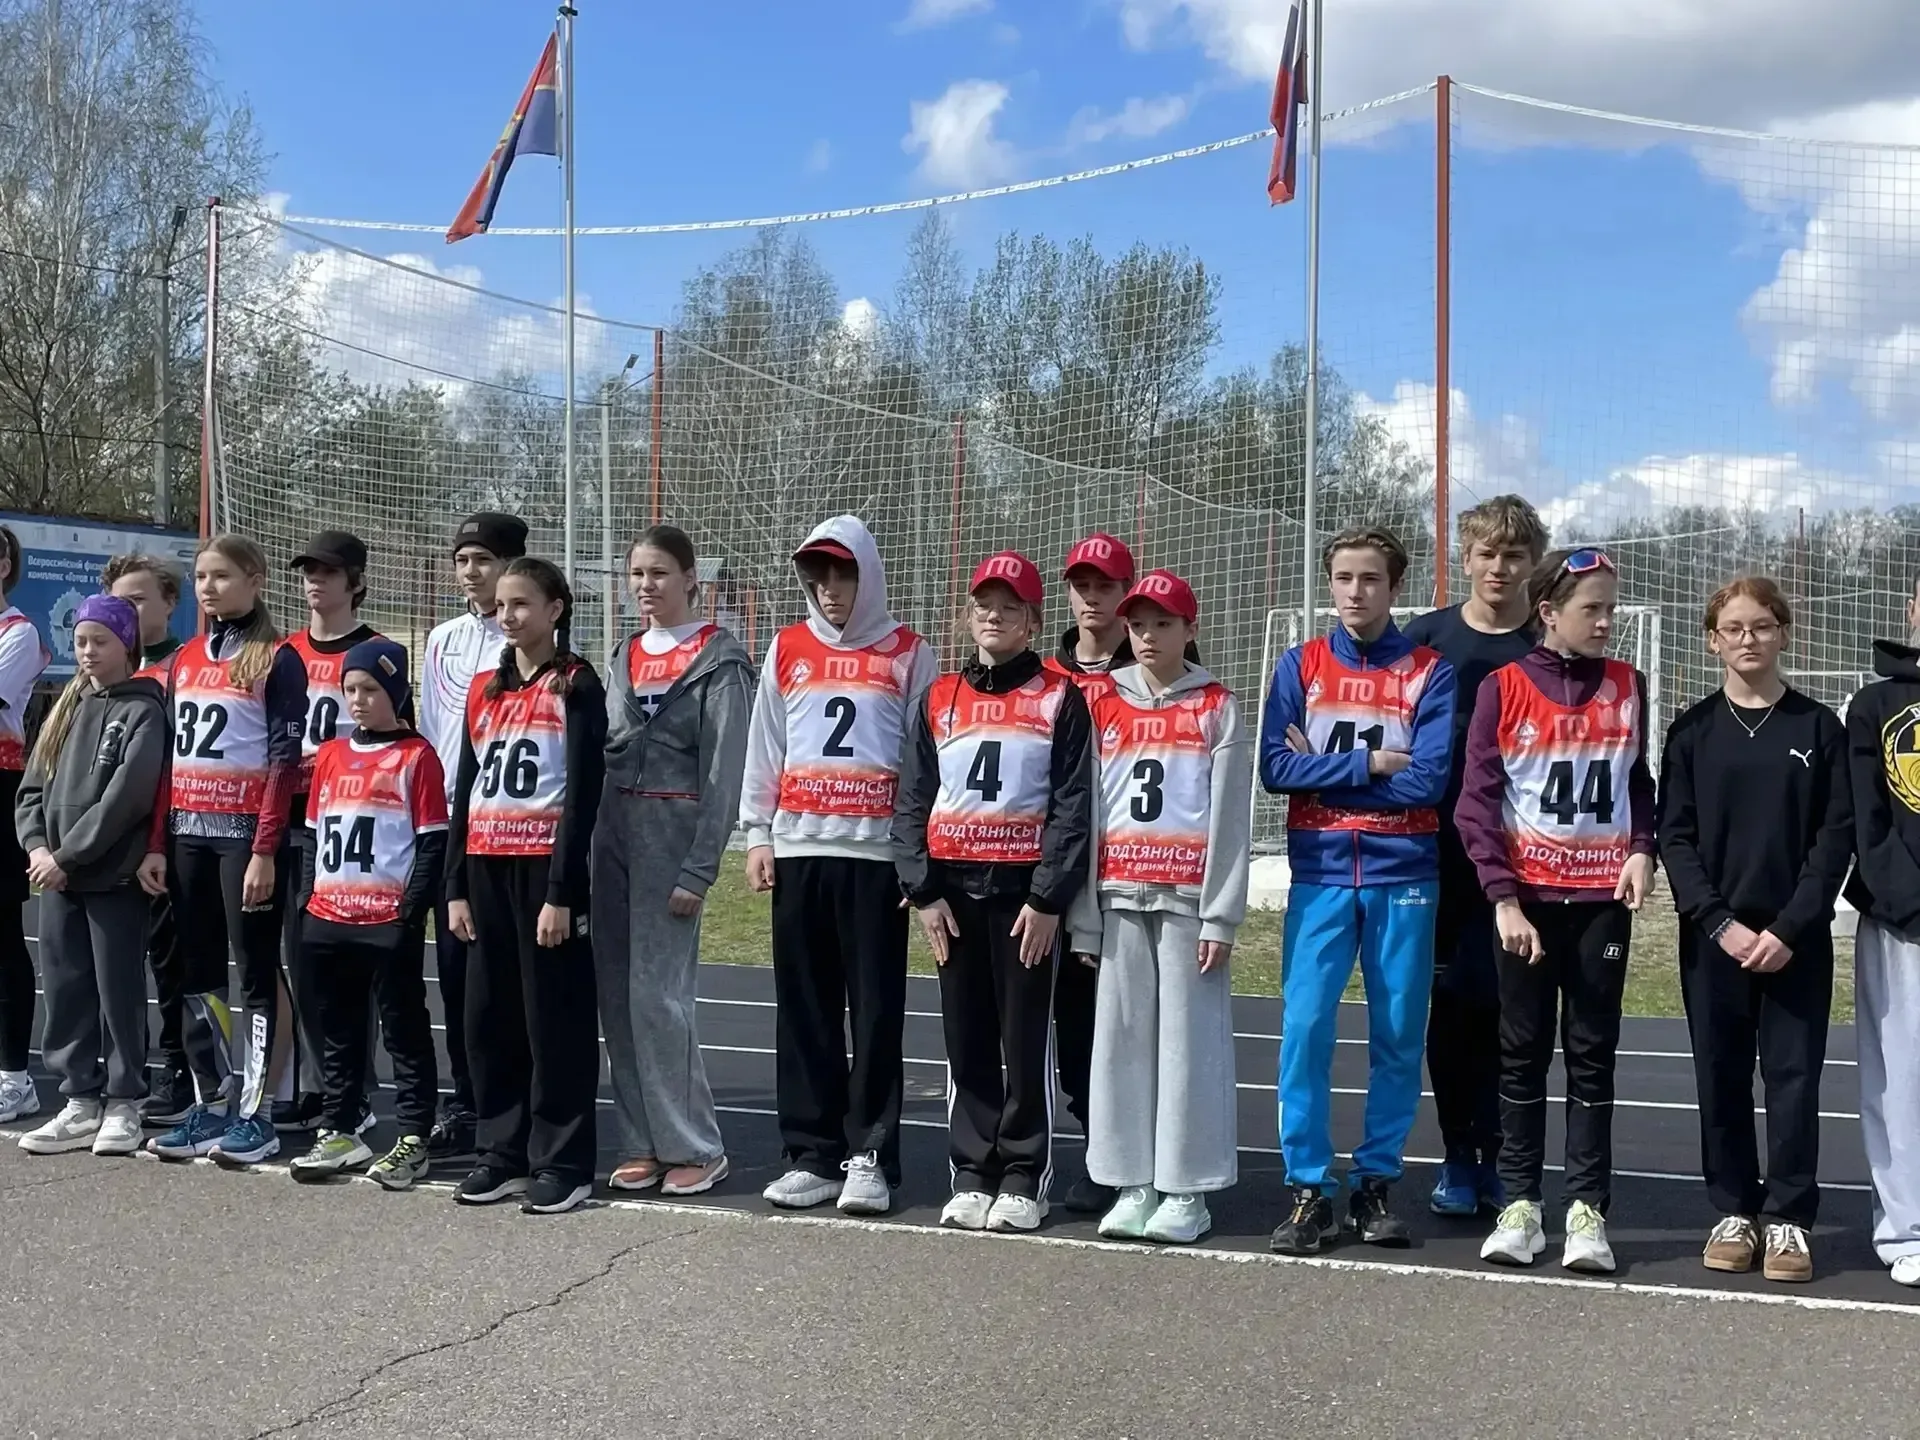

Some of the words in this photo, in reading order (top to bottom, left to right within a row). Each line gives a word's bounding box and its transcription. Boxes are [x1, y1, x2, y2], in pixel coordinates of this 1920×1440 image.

[1077, 538, 1112, 560] ГТО
[28, 555, 83, 569] Всероссийский
[984, 556, 1023, 578] ГТО
[28, 571, 64, 581] комплекс
[1135, 574, 1173, 595] ГТО
[192, 667, 223, 687] ГТО
[308, 659, 335, 680] ГТО
[638, 660, 667, 680] ГТО
[824, 656, 860, 679] ГТО
[1337, 677, 1376, 702] ГТО
[971, 700, 1006, 723] ГТО
[177, 701, 228, 759] 32
[822, 696, 857, 758] 2
[1132, 716, 1167, 741] ГТО
[1324, 720, 1384, 755] 41
[1553, 714, 1590, 740] ГТО
[482, 738, 540, 799] 56
[966, 740, 1003, 802] 4
[336, 775, 364, 797] ГТО
[1130, 758, 1164, 823] 3
[1540, 759, 1615, 825] 44
[322, 814, 376, 873] 54
[970, 841, 1033, 852] ДВИЖЕНИЮ
[1134, 861, 1197, 874] ДВИЖЕНИЮ
